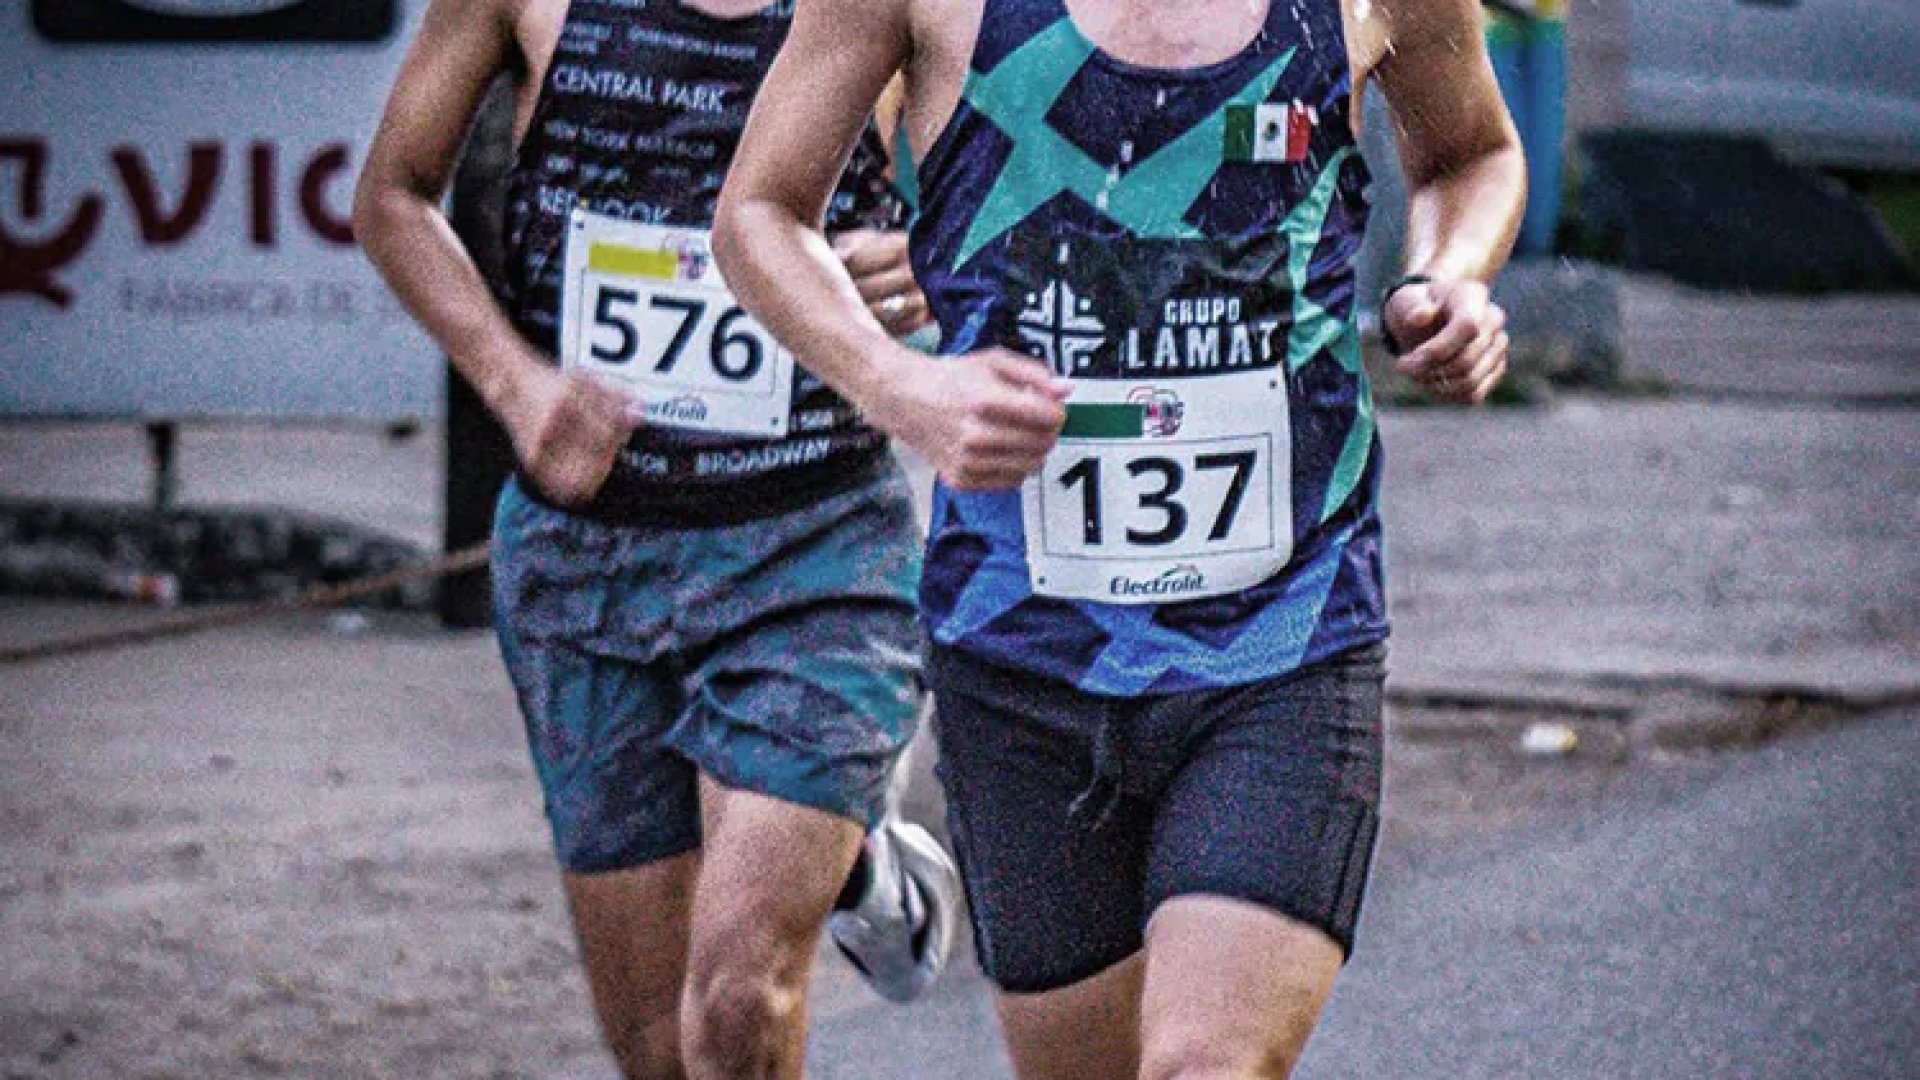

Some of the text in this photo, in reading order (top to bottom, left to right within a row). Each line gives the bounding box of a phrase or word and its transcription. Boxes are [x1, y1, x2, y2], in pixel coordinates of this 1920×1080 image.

[552, 63, 727, 113] CENTRAL PARK
[589, 285, 765, 382] 576
[1164, 296, 1242, 325] GRUPO
[1125, 321, 1280, 370] LAMAT
[695, 437, 832, 476] BROADWAY
[1056, 449, 1259, 546] 137
[1109, 572, 1208, 597] Electrolit
